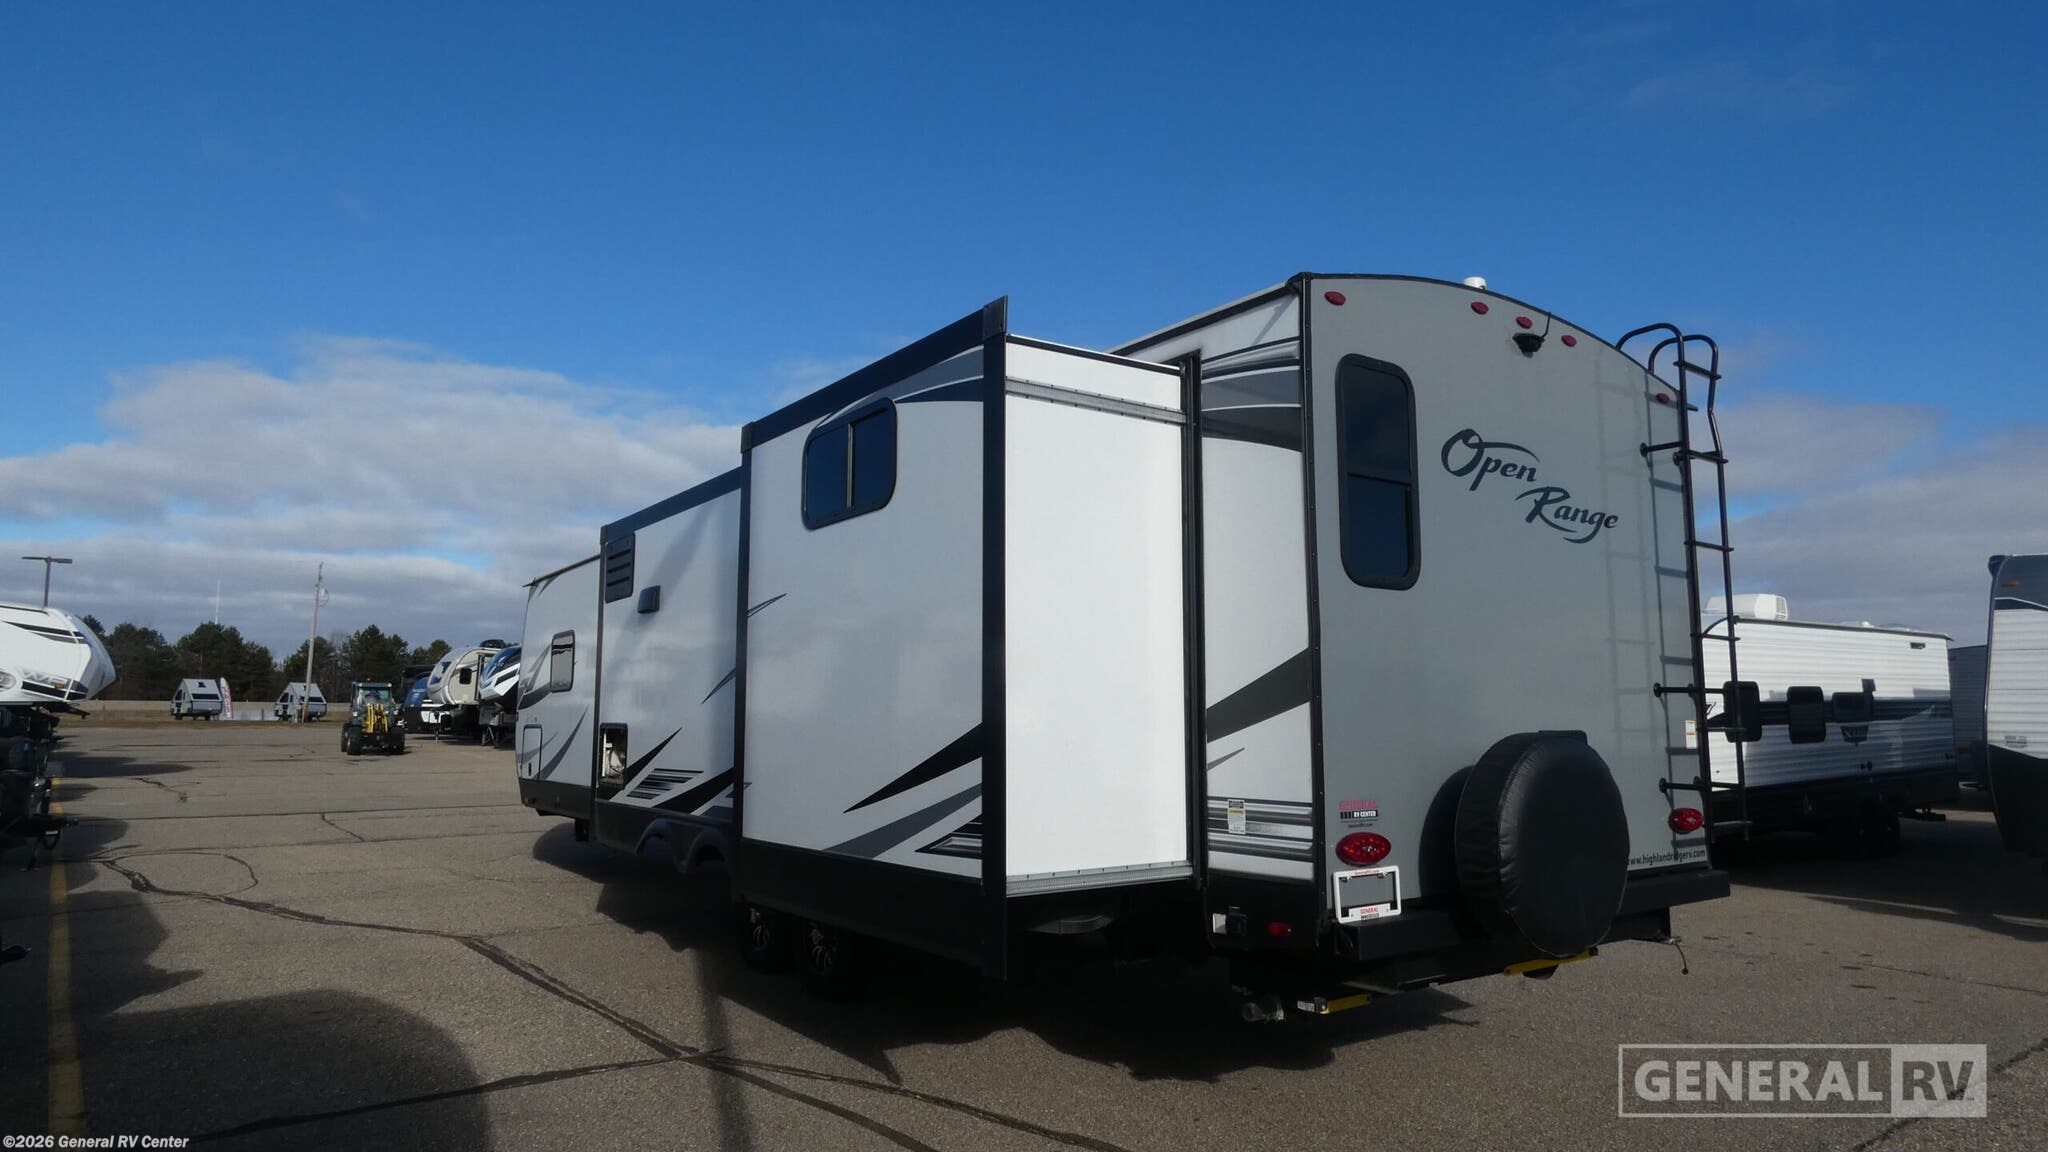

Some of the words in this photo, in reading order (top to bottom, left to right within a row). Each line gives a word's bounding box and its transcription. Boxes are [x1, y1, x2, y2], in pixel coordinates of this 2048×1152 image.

[1441, 429, 1540, 491] Open
[1515, 487, 1618, 543] Range
[1360, 810, 1376, 818] CENTER
[1360, 906, 1378, 915] GENERAL
